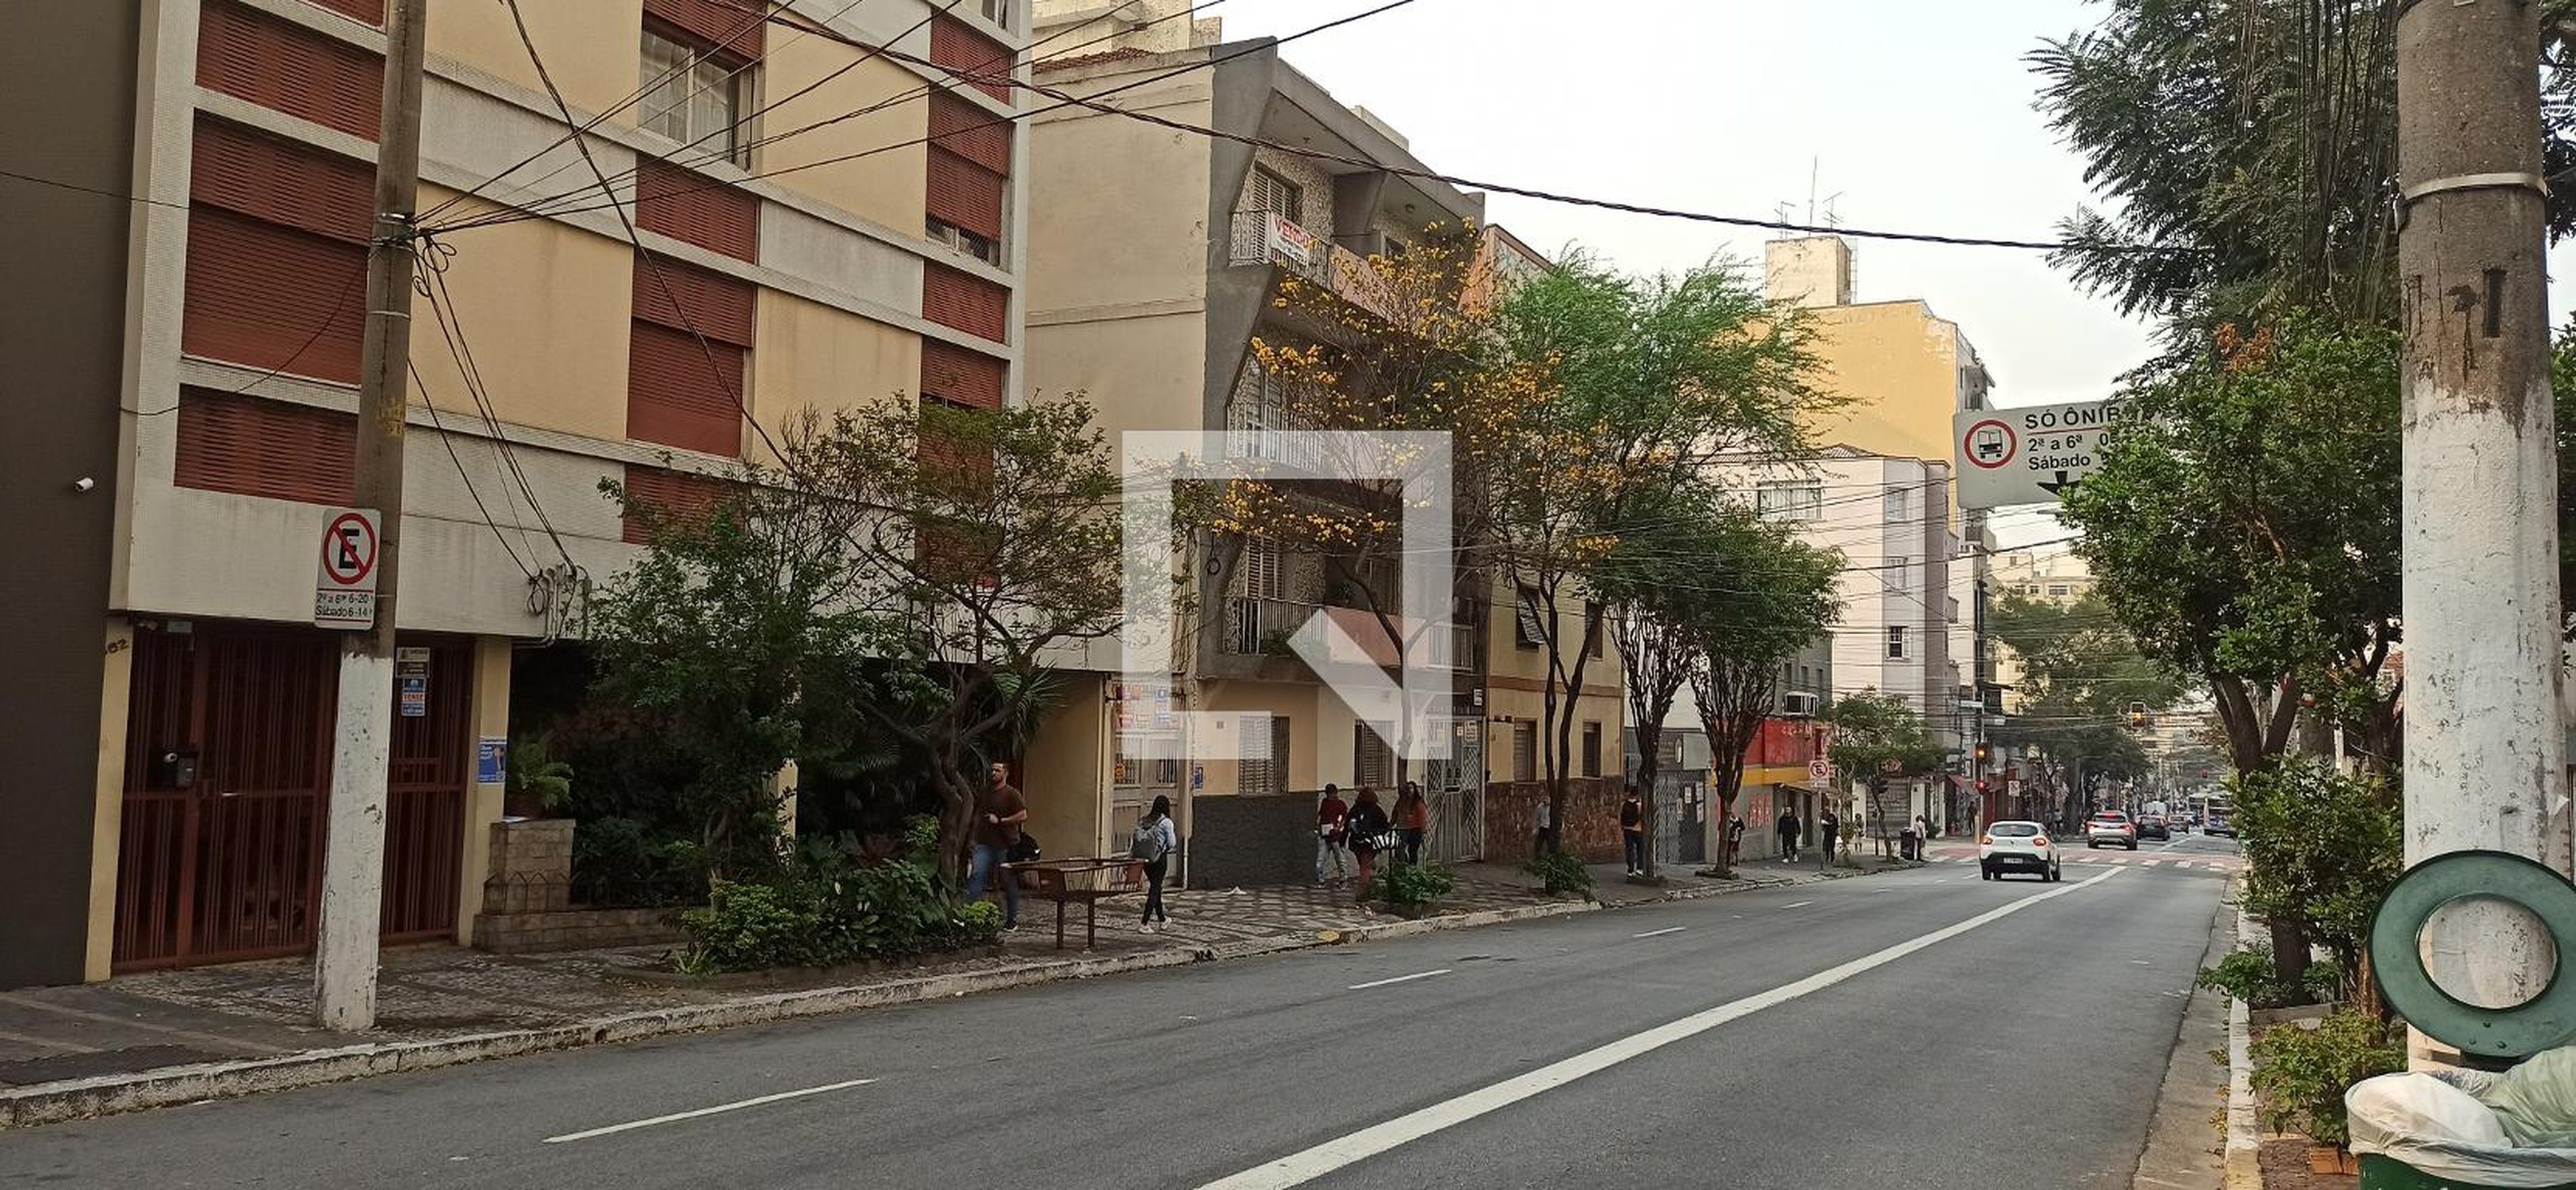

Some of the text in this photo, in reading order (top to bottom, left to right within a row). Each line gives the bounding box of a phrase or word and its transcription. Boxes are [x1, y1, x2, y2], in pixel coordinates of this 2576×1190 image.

[1275, 216, 1309, 249] VENDO
[2025, 407, 2120, 429] SÓ ÔNIB
[2029, 438, 2045, 451] 2ª
[2050, 439, 2060, 450] a
[2066, 434, 2082, 448] 6ª
[2029, 453, 2090, 470] Sábado
